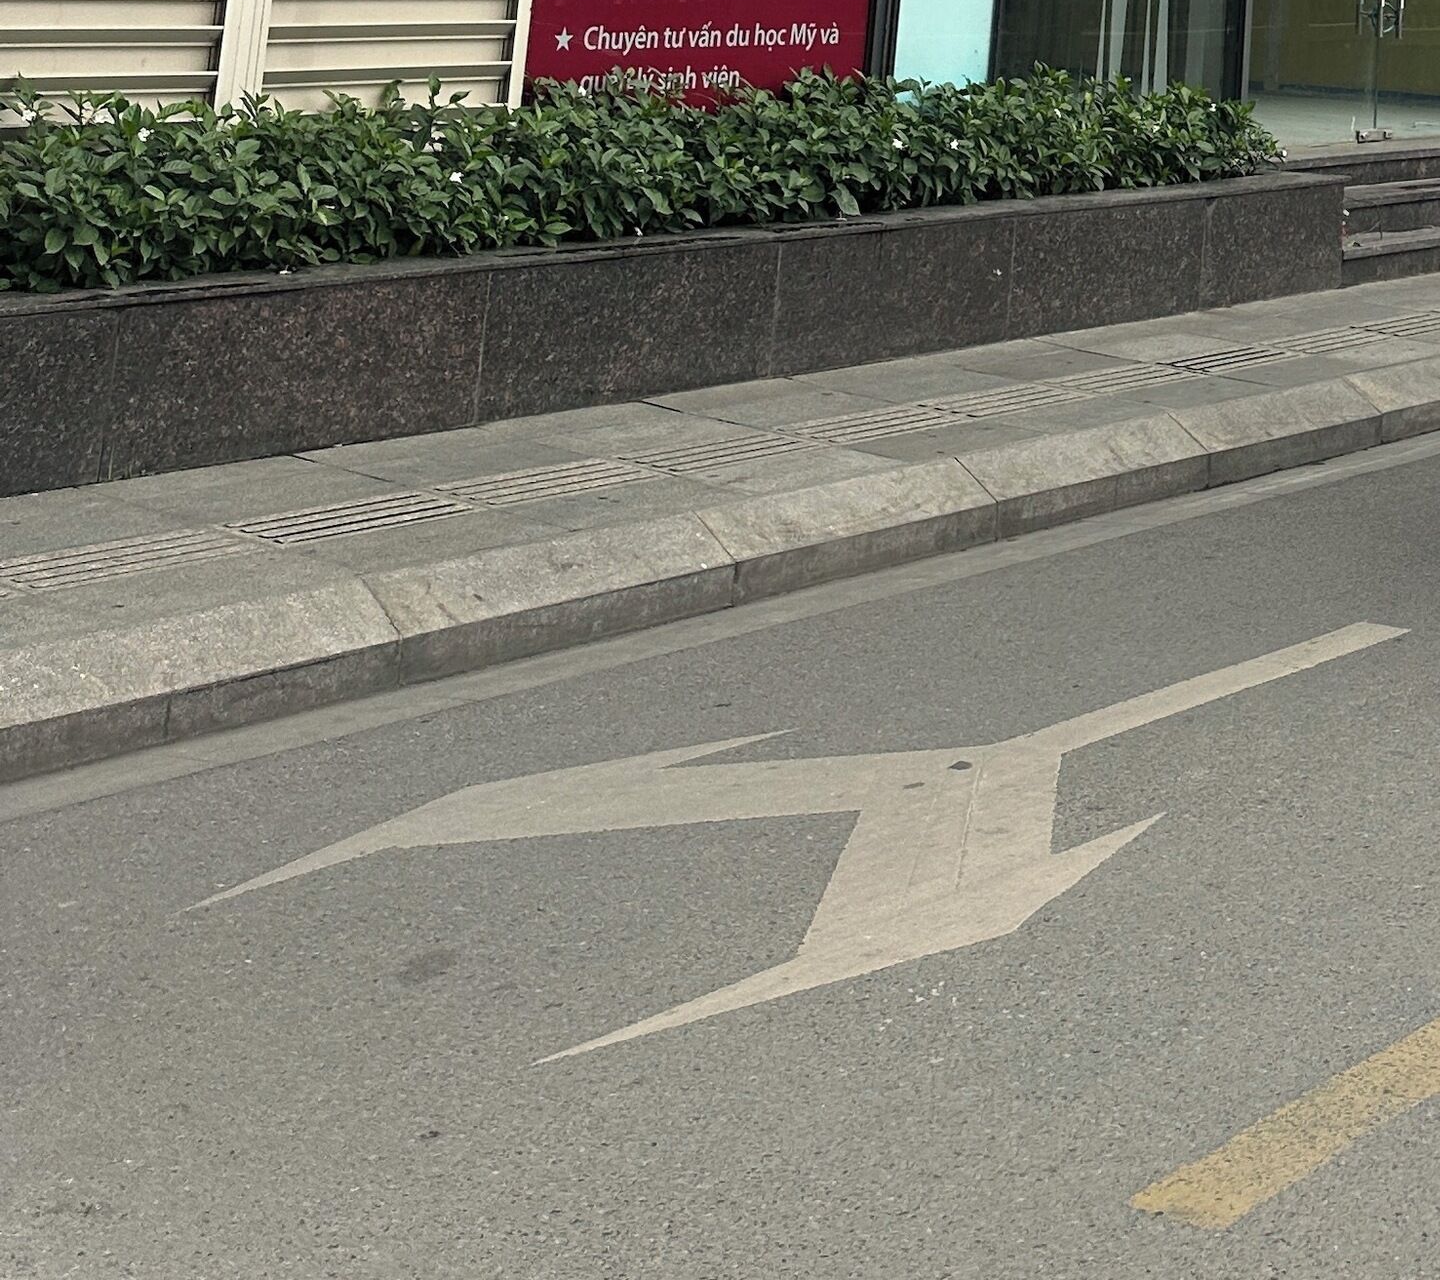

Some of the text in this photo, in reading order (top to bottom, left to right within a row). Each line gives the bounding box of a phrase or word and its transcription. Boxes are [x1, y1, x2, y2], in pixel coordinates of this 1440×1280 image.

[584, 21, 840, 55] Chuyên tư vấn du học Mỹ và
